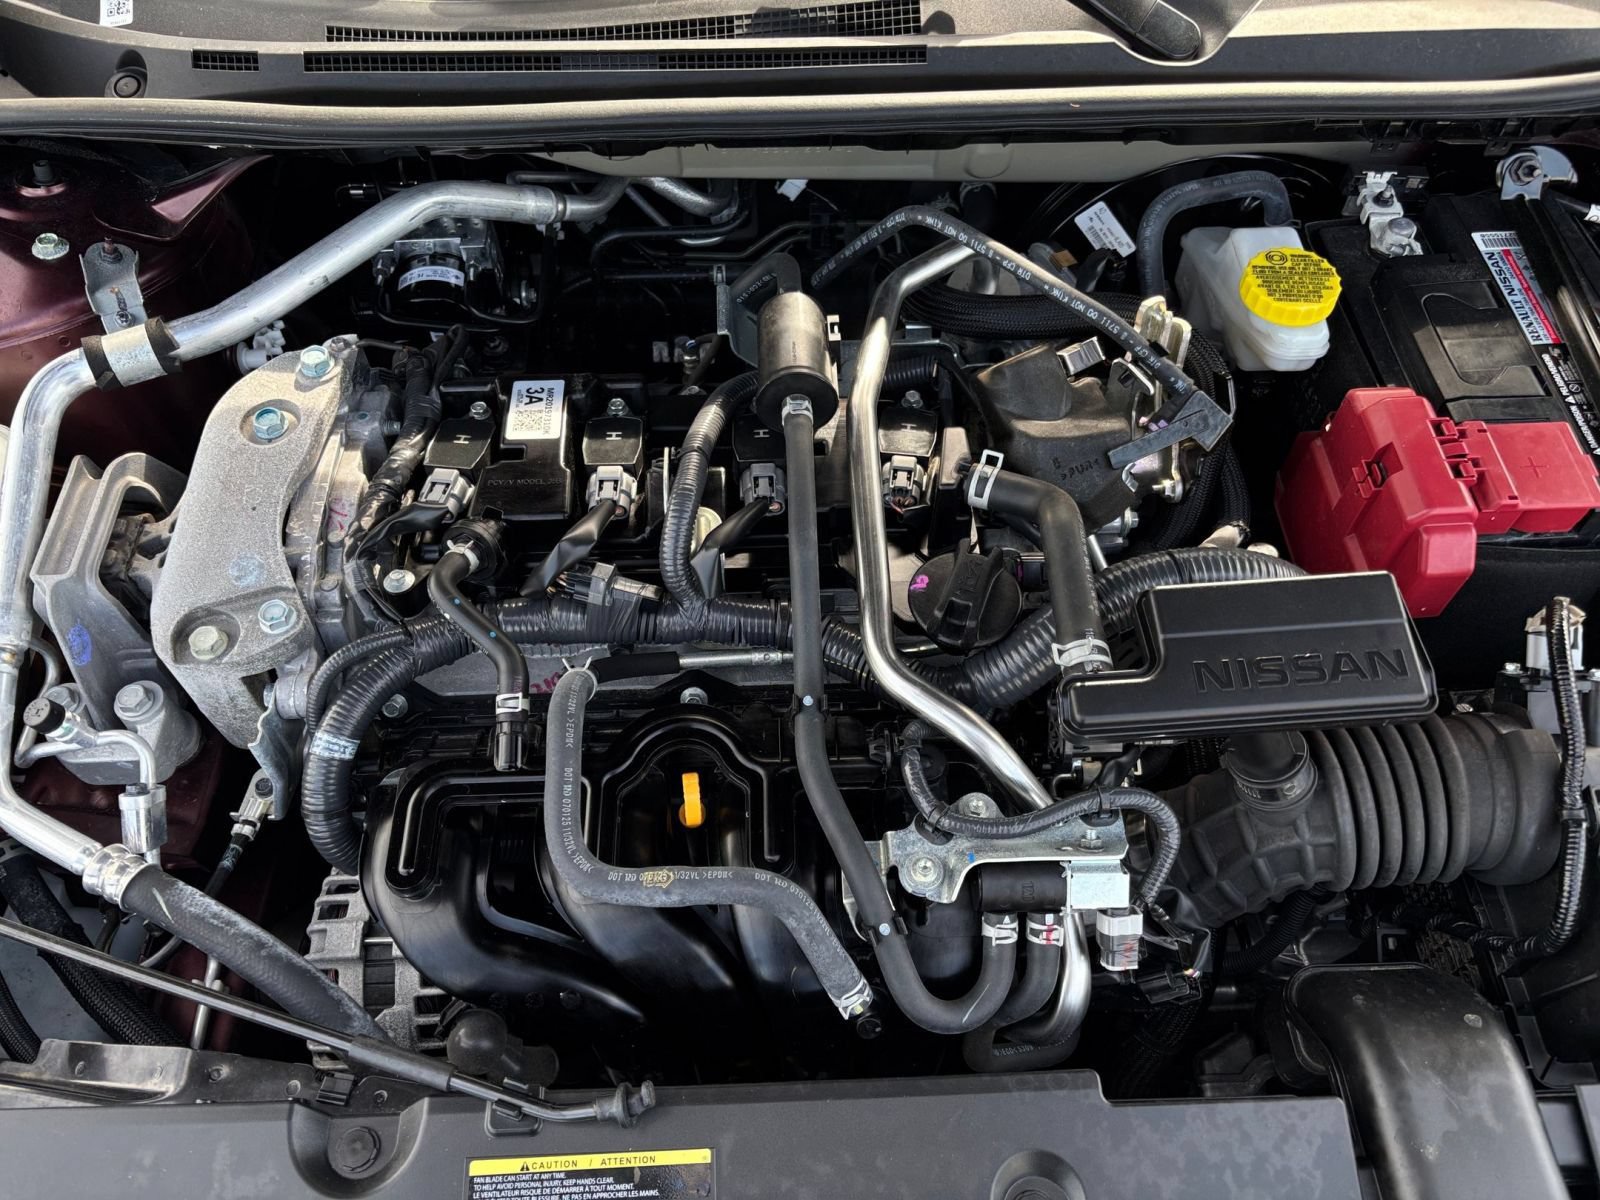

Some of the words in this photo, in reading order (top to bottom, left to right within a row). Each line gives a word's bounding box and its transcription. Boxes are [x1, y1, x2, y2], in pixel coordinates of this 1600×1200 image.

[926, 216, 942, 229] KINK
[944, 225, 957, 237] NOT
[959, 232, 968, 243] DO
[970, 239, 986, 254] 5711
[1002, 260, 1016, 270] CFP
[1017, 267, 1032, 280] DTR
[1485, 252, 1518, 297] NISSAN
[1051, 288, 1069, 303] KINK
[1070, 300, 1086, 313] NOT
[1086, 309, 1099, 319] DO
[1511, 299, 1542, 342] RENAULT
[1100, 318, 1120, 334] 5711
[1542, 354, 1570, 396] PELIGRO/VENENO
[524, 387, 545, 406] 3A
[1570, 405, 1598, 448] DANGER/POISON
[1192, 648, 1410, 693] NISSAN
[564, 768, 573, 781] DOT
[562, 798, 571, 826] 070125
[608, 872, 622, 880] DOT
[755, 872, 770, 882] DOT
[790, 885, 813, 910] 070125
[532, 1160, 578, 1170] CAUTION
[600, 1156, 656, 1166] ATTENTION
[481, 1190, 520, 1198] VENTILATEUR
[592, 1191, 627, 1199] APPROCHER
